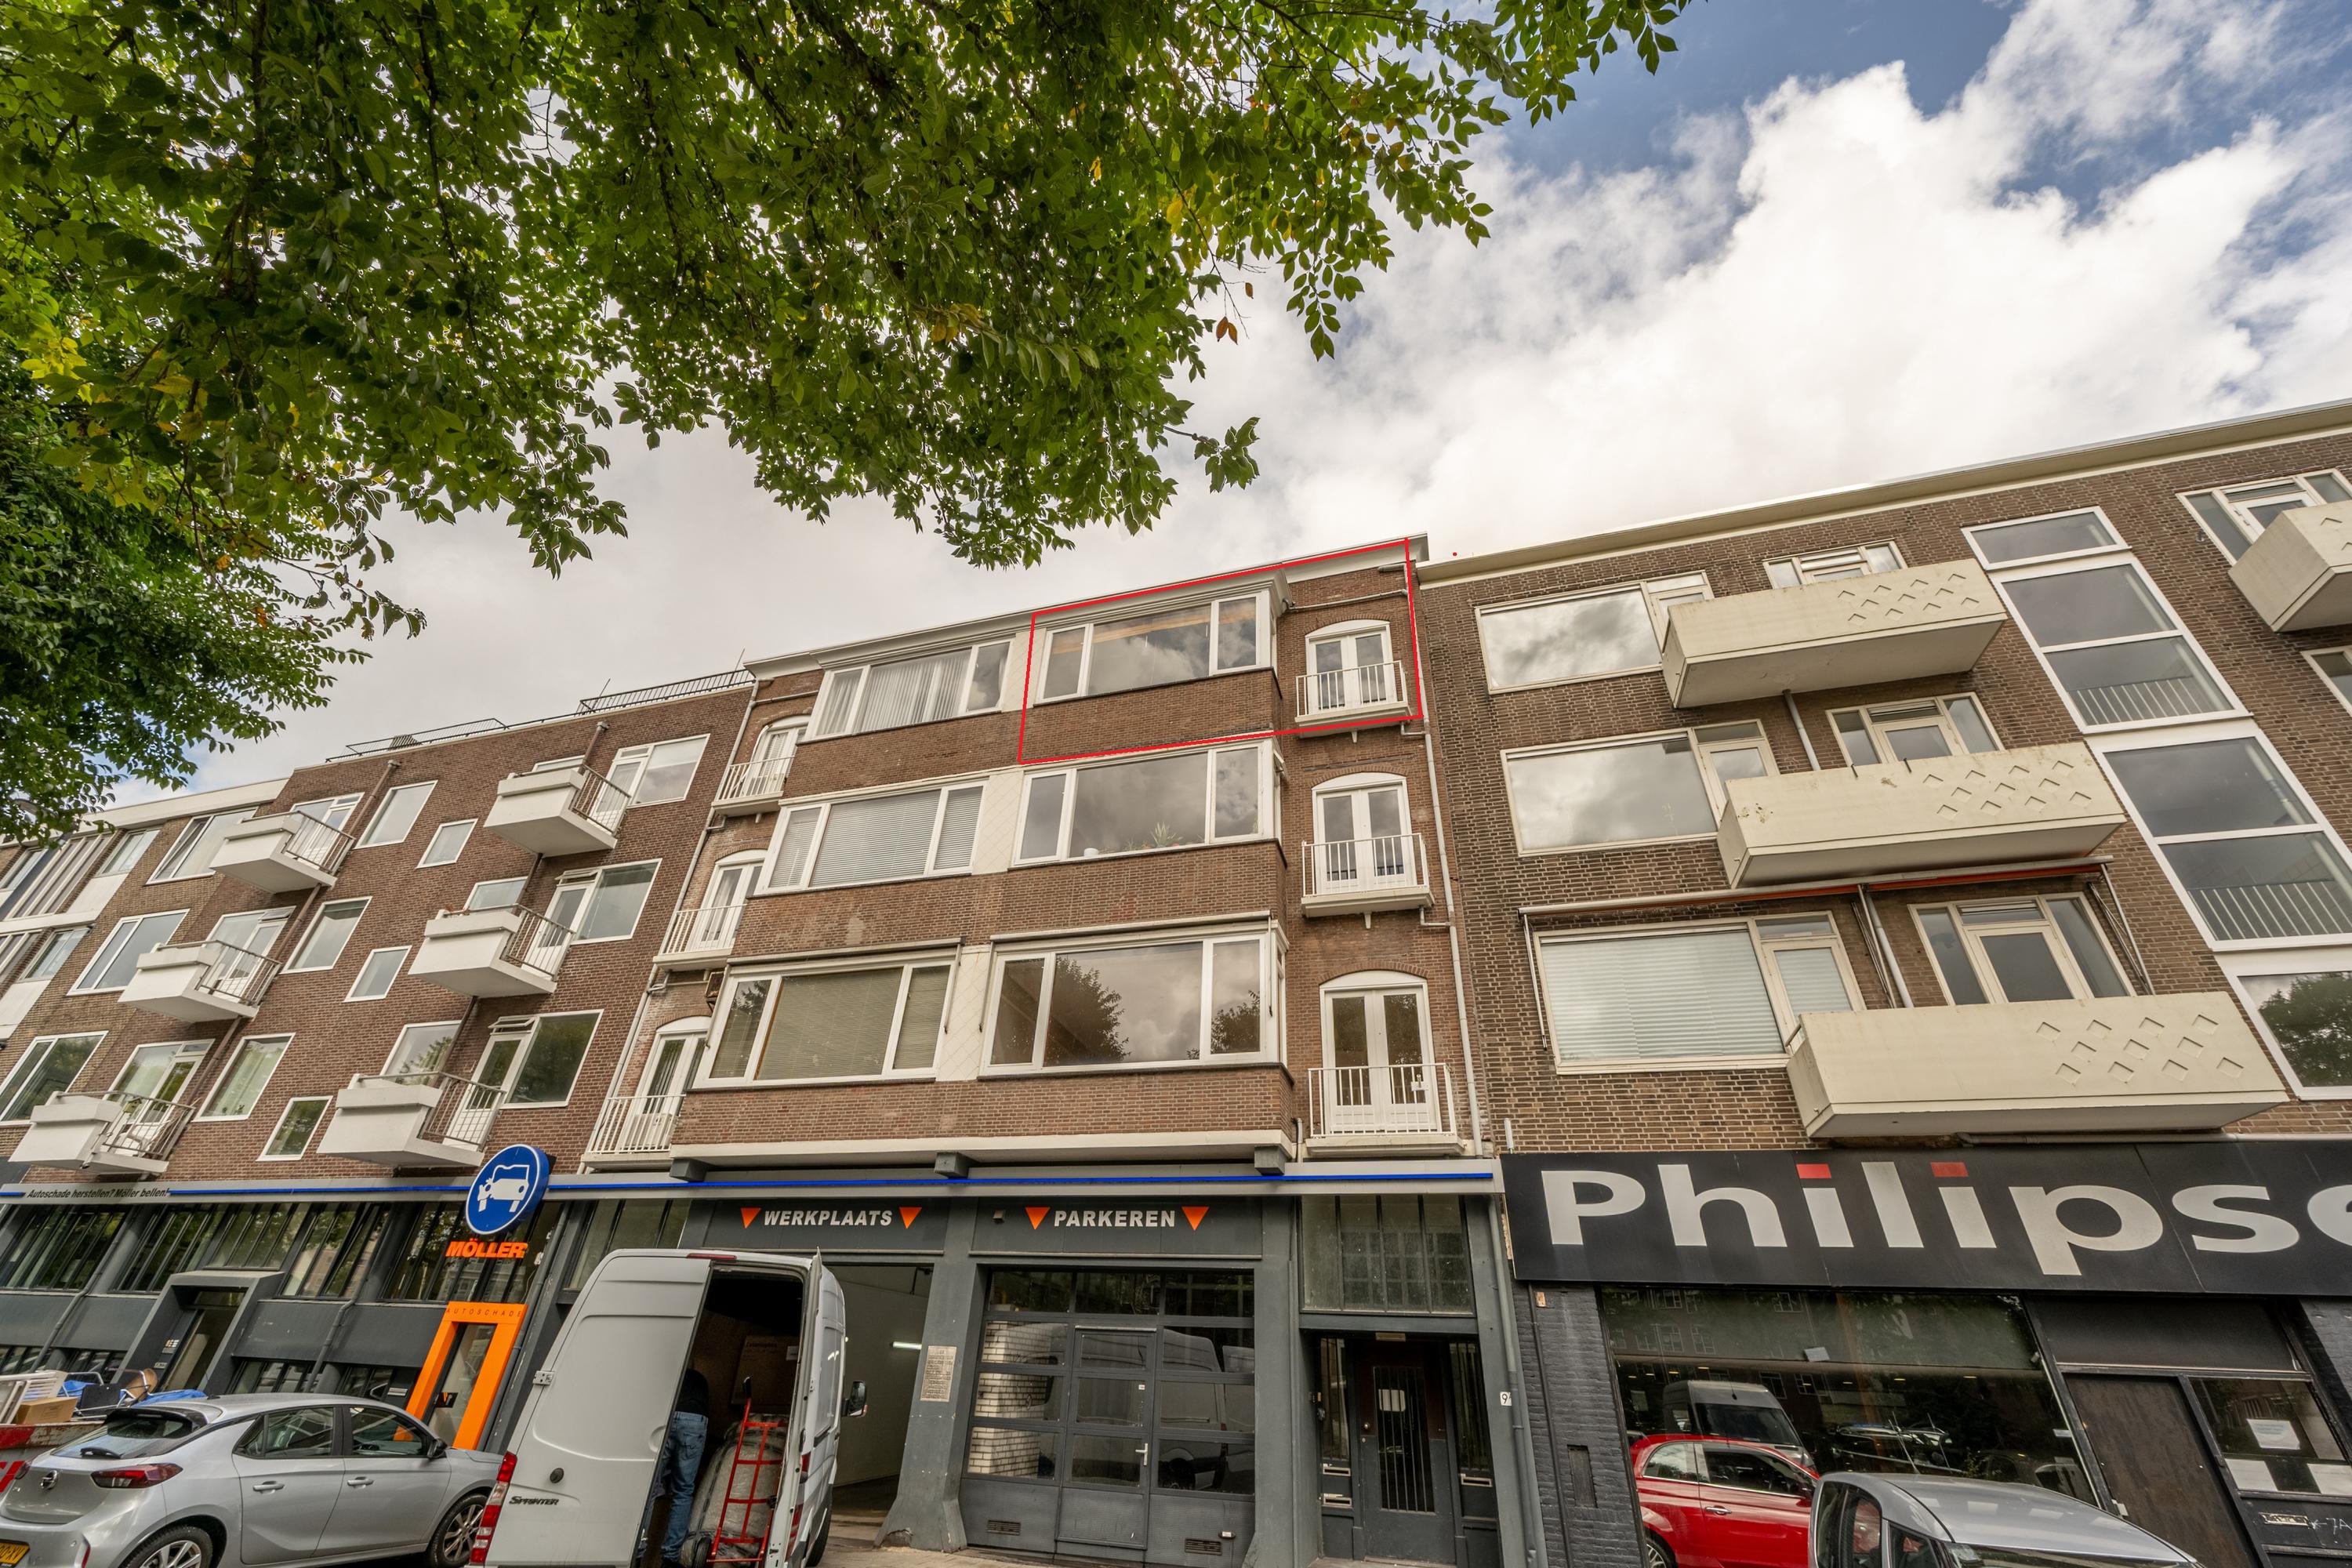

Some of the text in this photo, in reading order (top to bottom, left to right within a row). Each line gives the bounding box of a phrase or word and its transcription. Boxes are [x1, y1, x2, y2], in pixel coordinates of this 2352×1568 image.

[27, 1188, 170, 1198] Autoschade herstellen? Möller bellen!
[764, 1210, 893, 1226] WERKPLAATS
[1054, 1210, 1175, 1227] PARKEREN
[445, 1238, 528, 1258] MÖLLER
[446, 1308, 523, 1317] AUTOSCHADE
